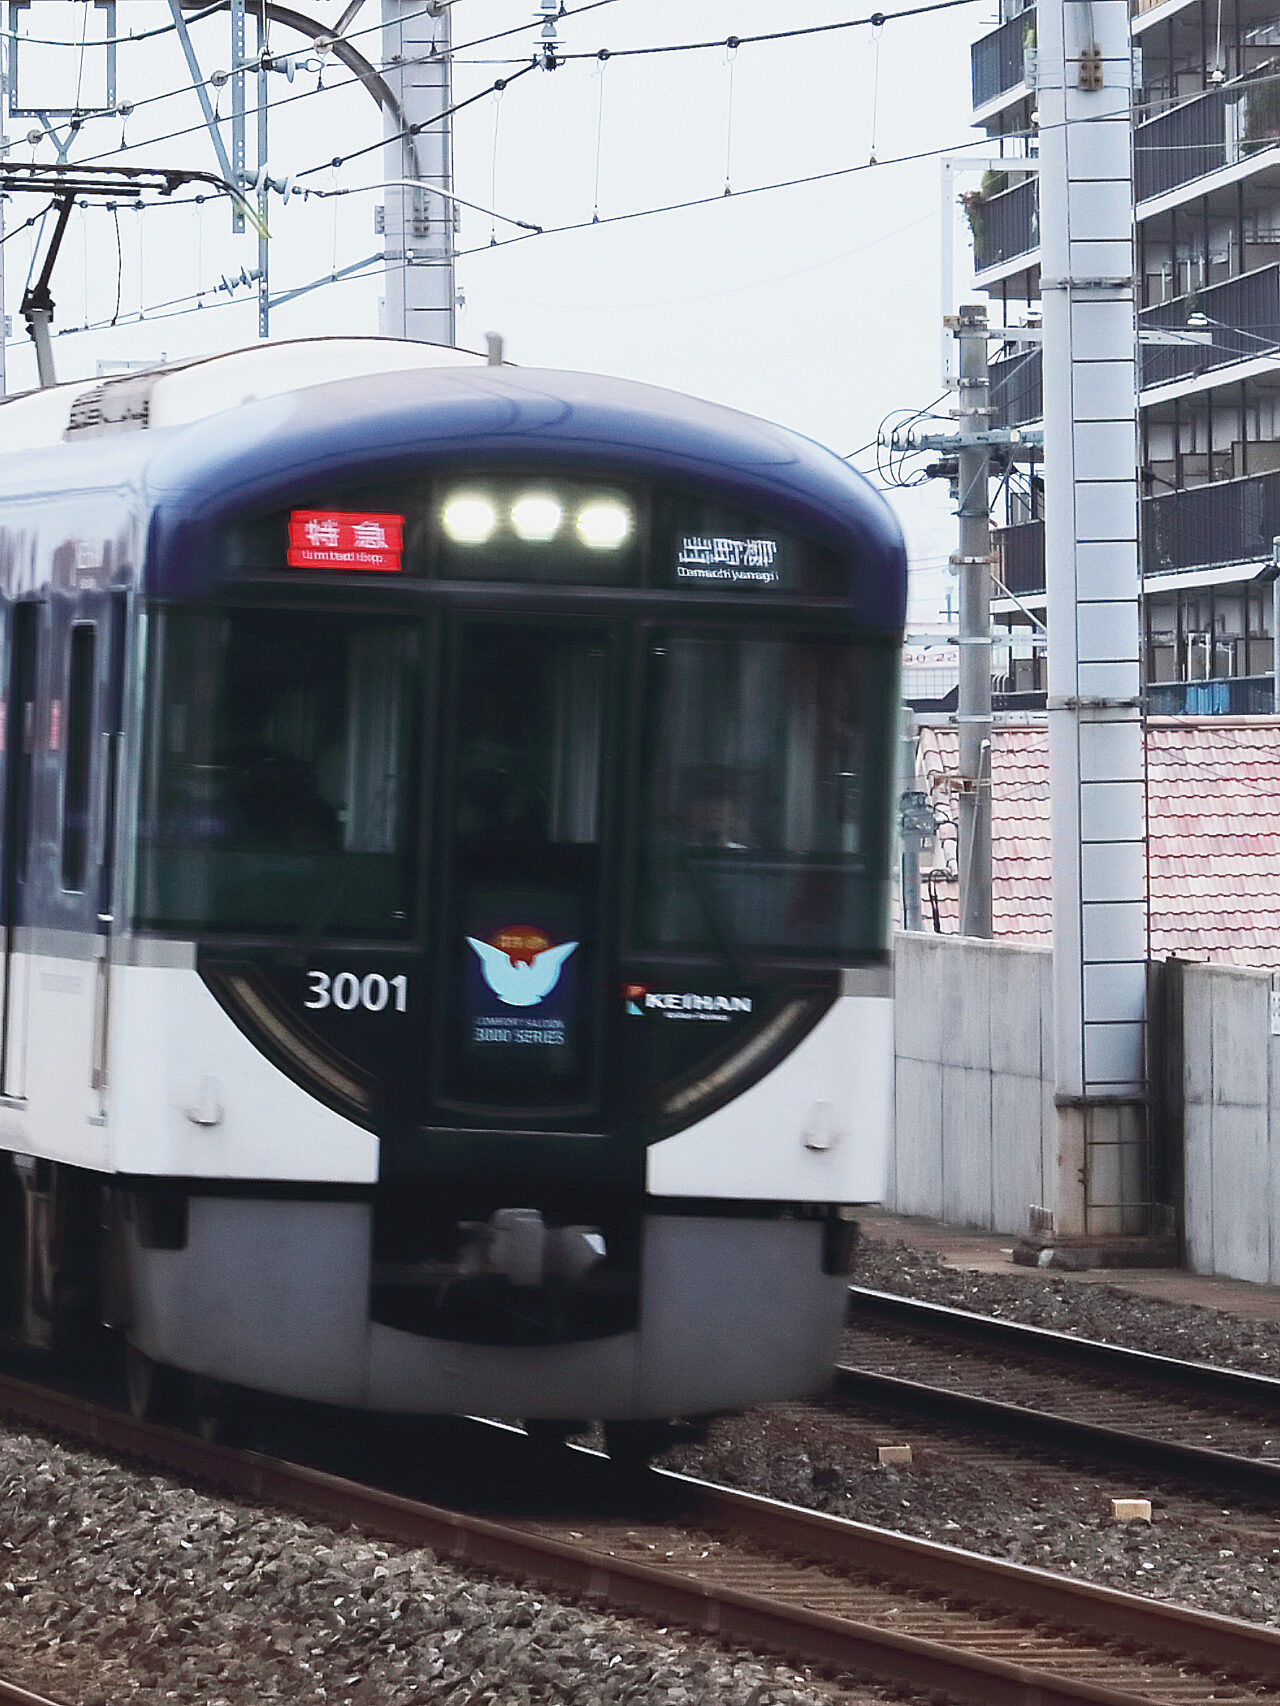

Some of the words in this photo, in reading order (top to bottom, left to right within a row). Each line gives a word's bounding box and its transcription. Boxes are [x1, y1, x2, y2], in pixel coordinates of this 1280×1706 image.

[678, 537, 777, 567] 出町柳
[304, 970, 407, 1012] 3001
[645, 993, 752, 1012] KEIHAN
[515, 1029, 565, 1045] SERIES
